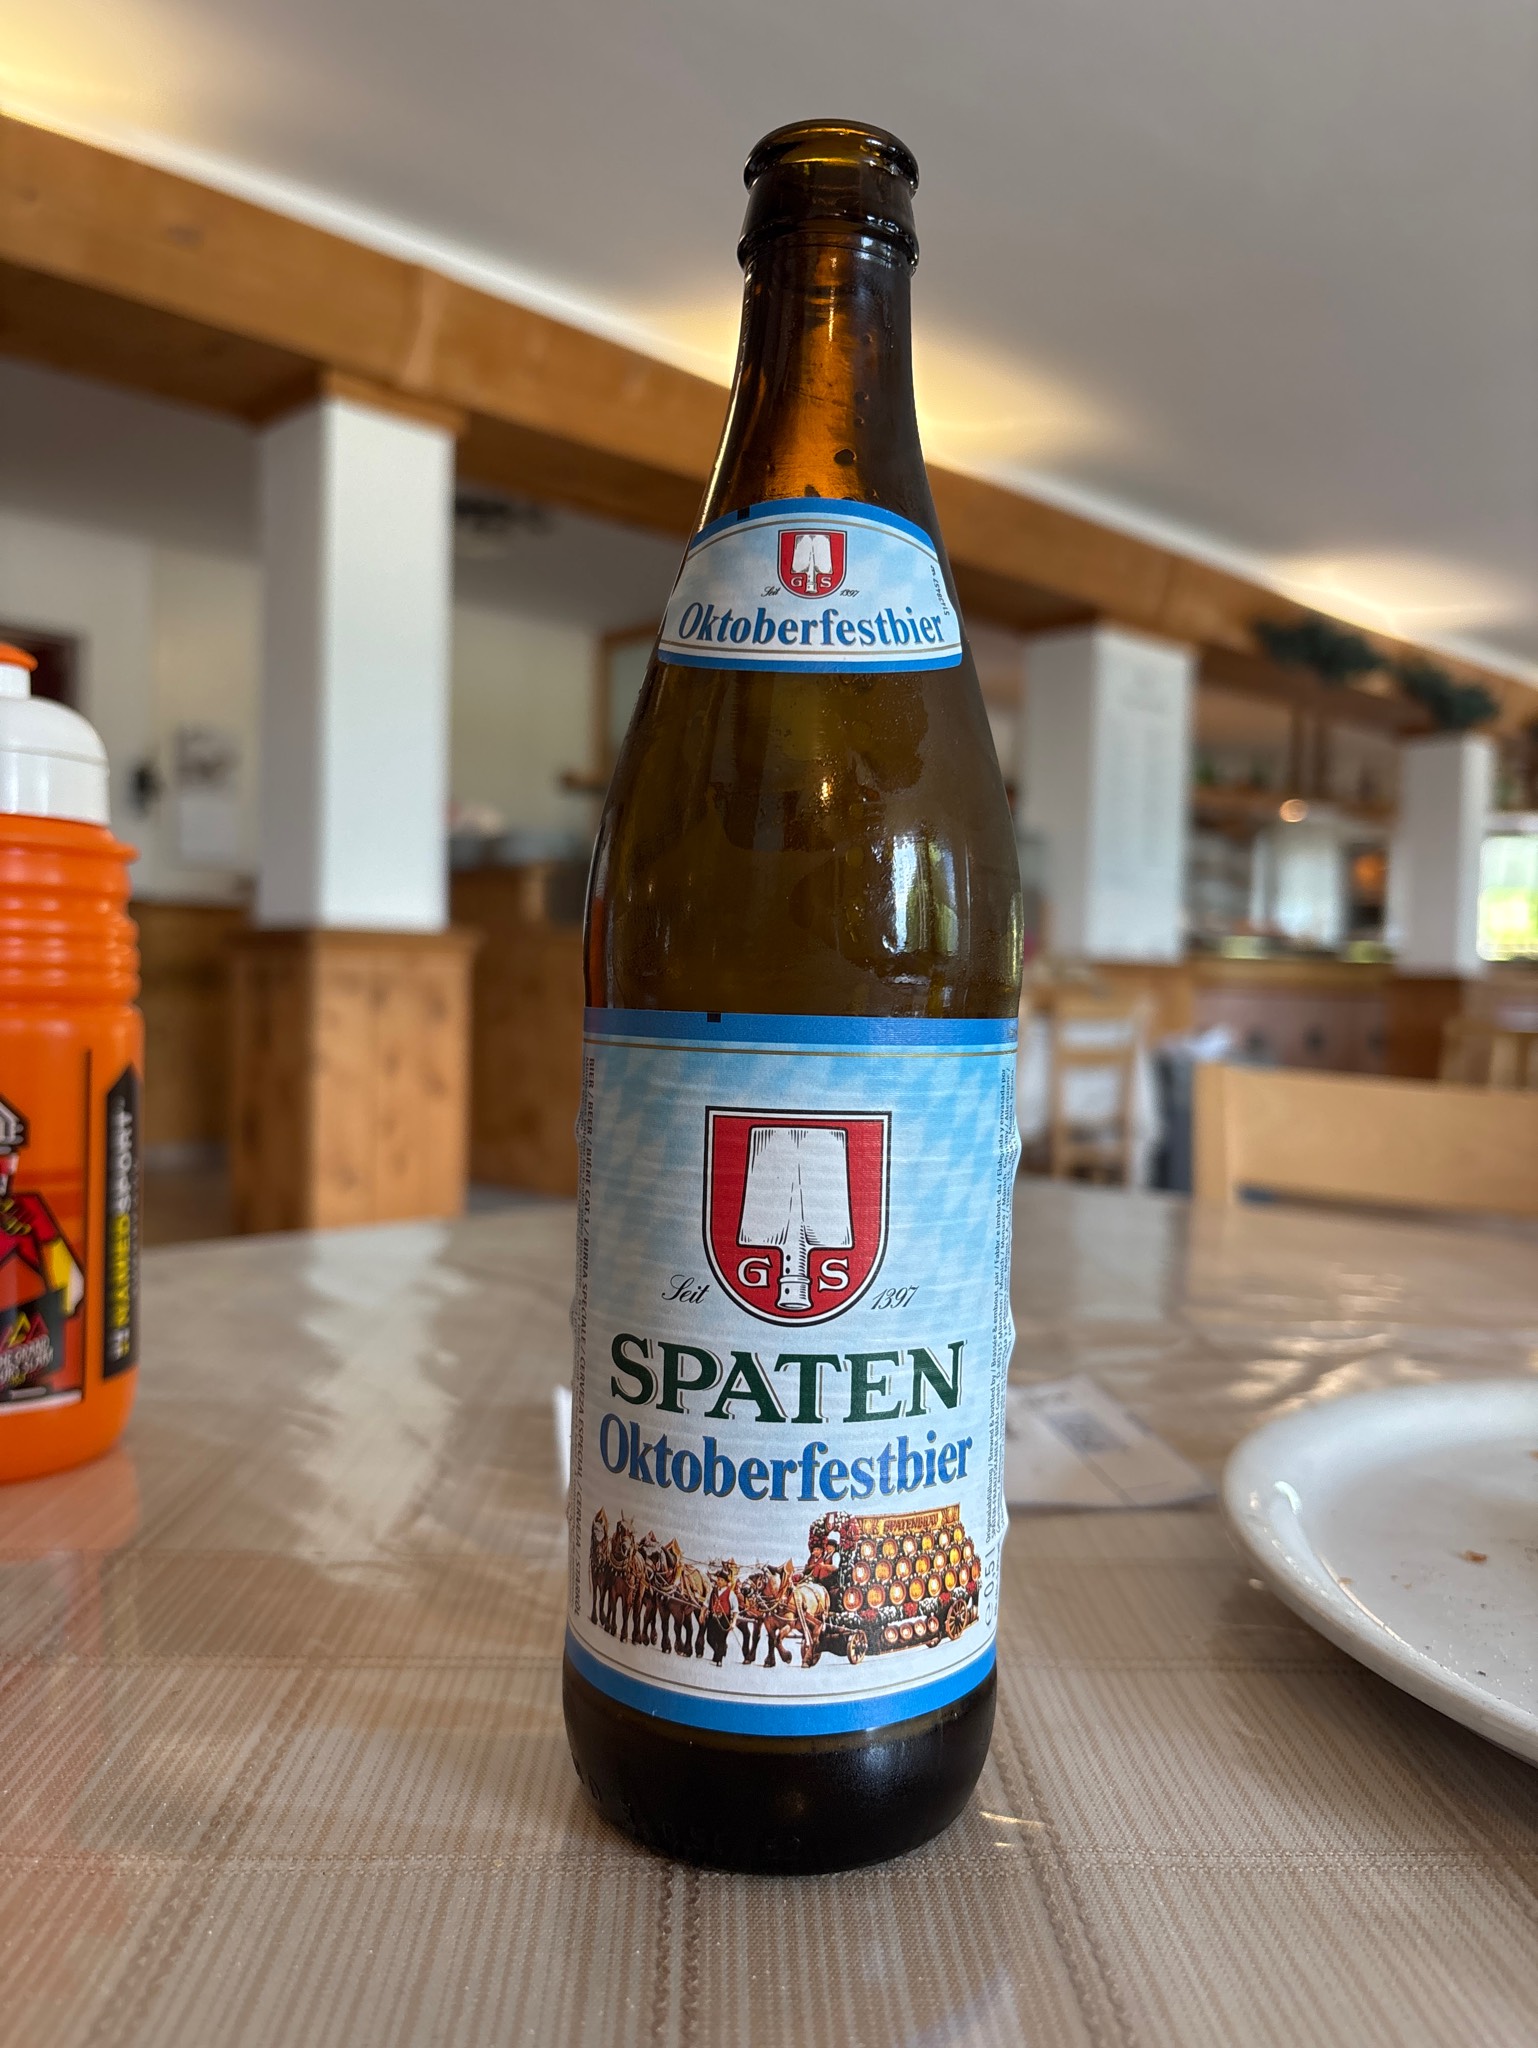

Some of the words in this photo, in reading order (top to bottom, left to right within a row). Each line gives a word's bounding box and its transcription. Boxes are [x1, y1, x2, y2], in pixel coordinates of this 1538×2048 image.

[760, 585, 781, 597] Seit
[790, 576, 802, 587] G
[820, 576, 832, 587] S
[678, 602, 945, 646] Oktoberfestbier
[586, 1101, 594, 1135] BEER
[661, 1274, 711, 1304] Seit
[870, 1285, 920, 1310] 1397
[737, 1256, 772, 1287] G
[818, 1256, 849, 1292] S
[610, 1333, 968, 1423] SPATEN
[600, 1413, 973, 1501] Oktoberfestbier
